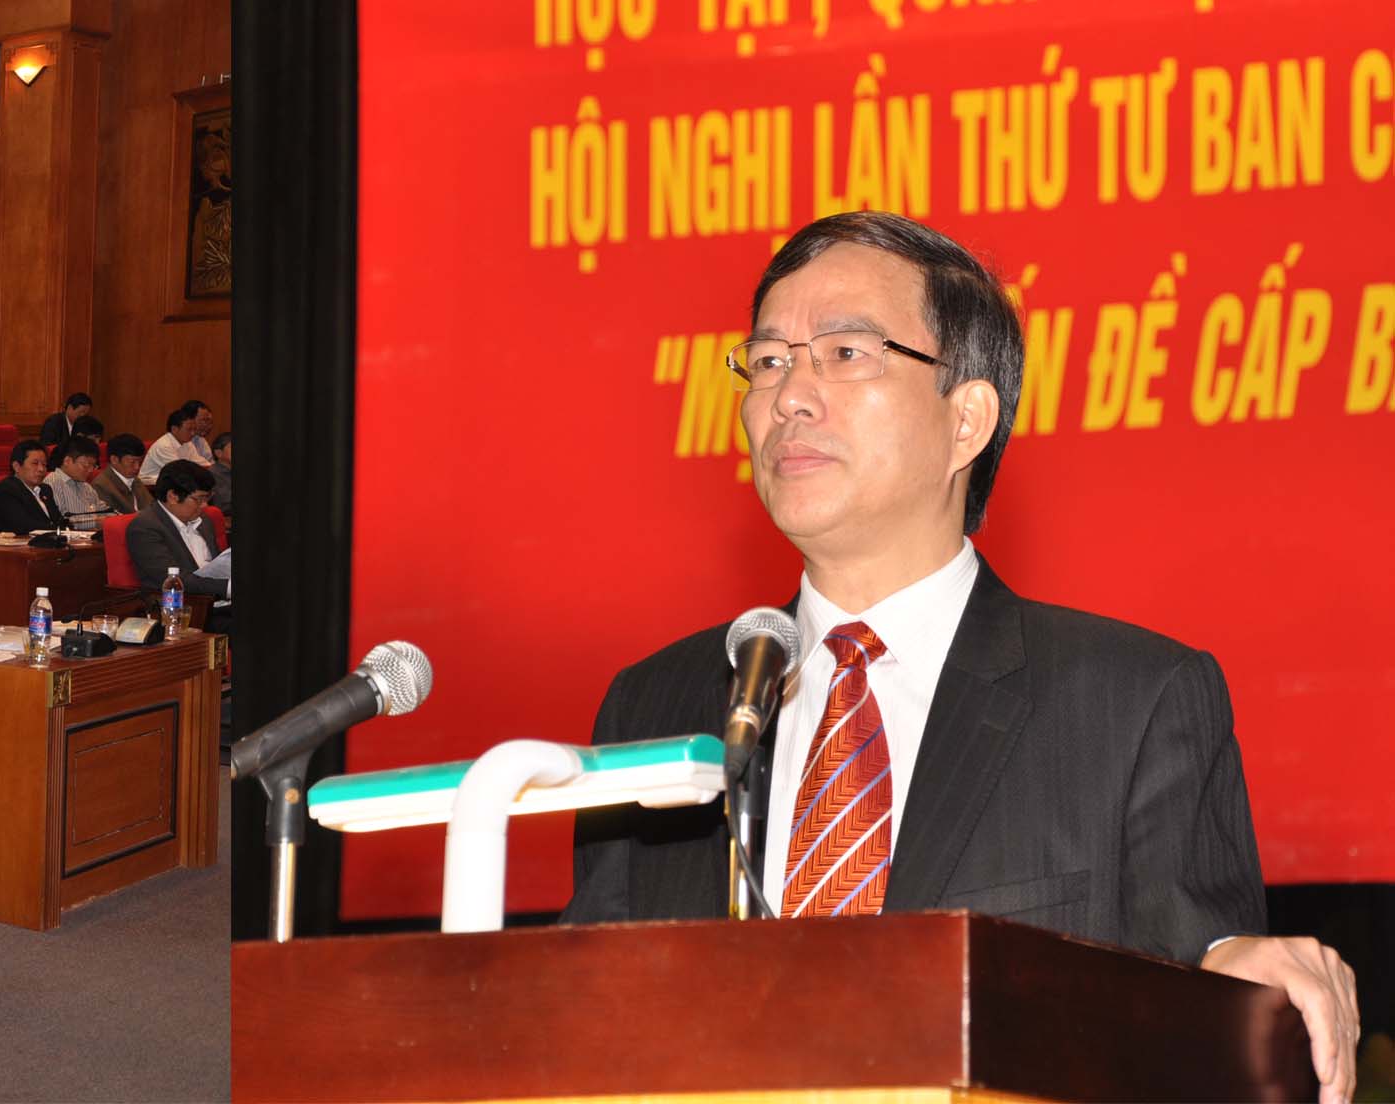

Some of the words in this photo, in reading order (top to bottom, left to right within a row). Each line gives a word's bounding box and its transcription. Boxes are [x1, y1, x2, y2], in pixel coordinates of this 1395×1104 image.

[531, 97, 626, 271] HỘI
[649, 107, 791, 255] NGHỊ
[813, 54, 932, 222] LẦN
[951, 46, 1078, 214] THỨ
[1090, 59, 1178, 203] TƯ
[1192, 58, 1325, 194] BAN
[1350, 49, 1395, 182] C
[1082, 253, 1178, 432] ĐỀ
[1190, 244, 1333, 425] CẤP
[1344, 283, 1395, 415] B
